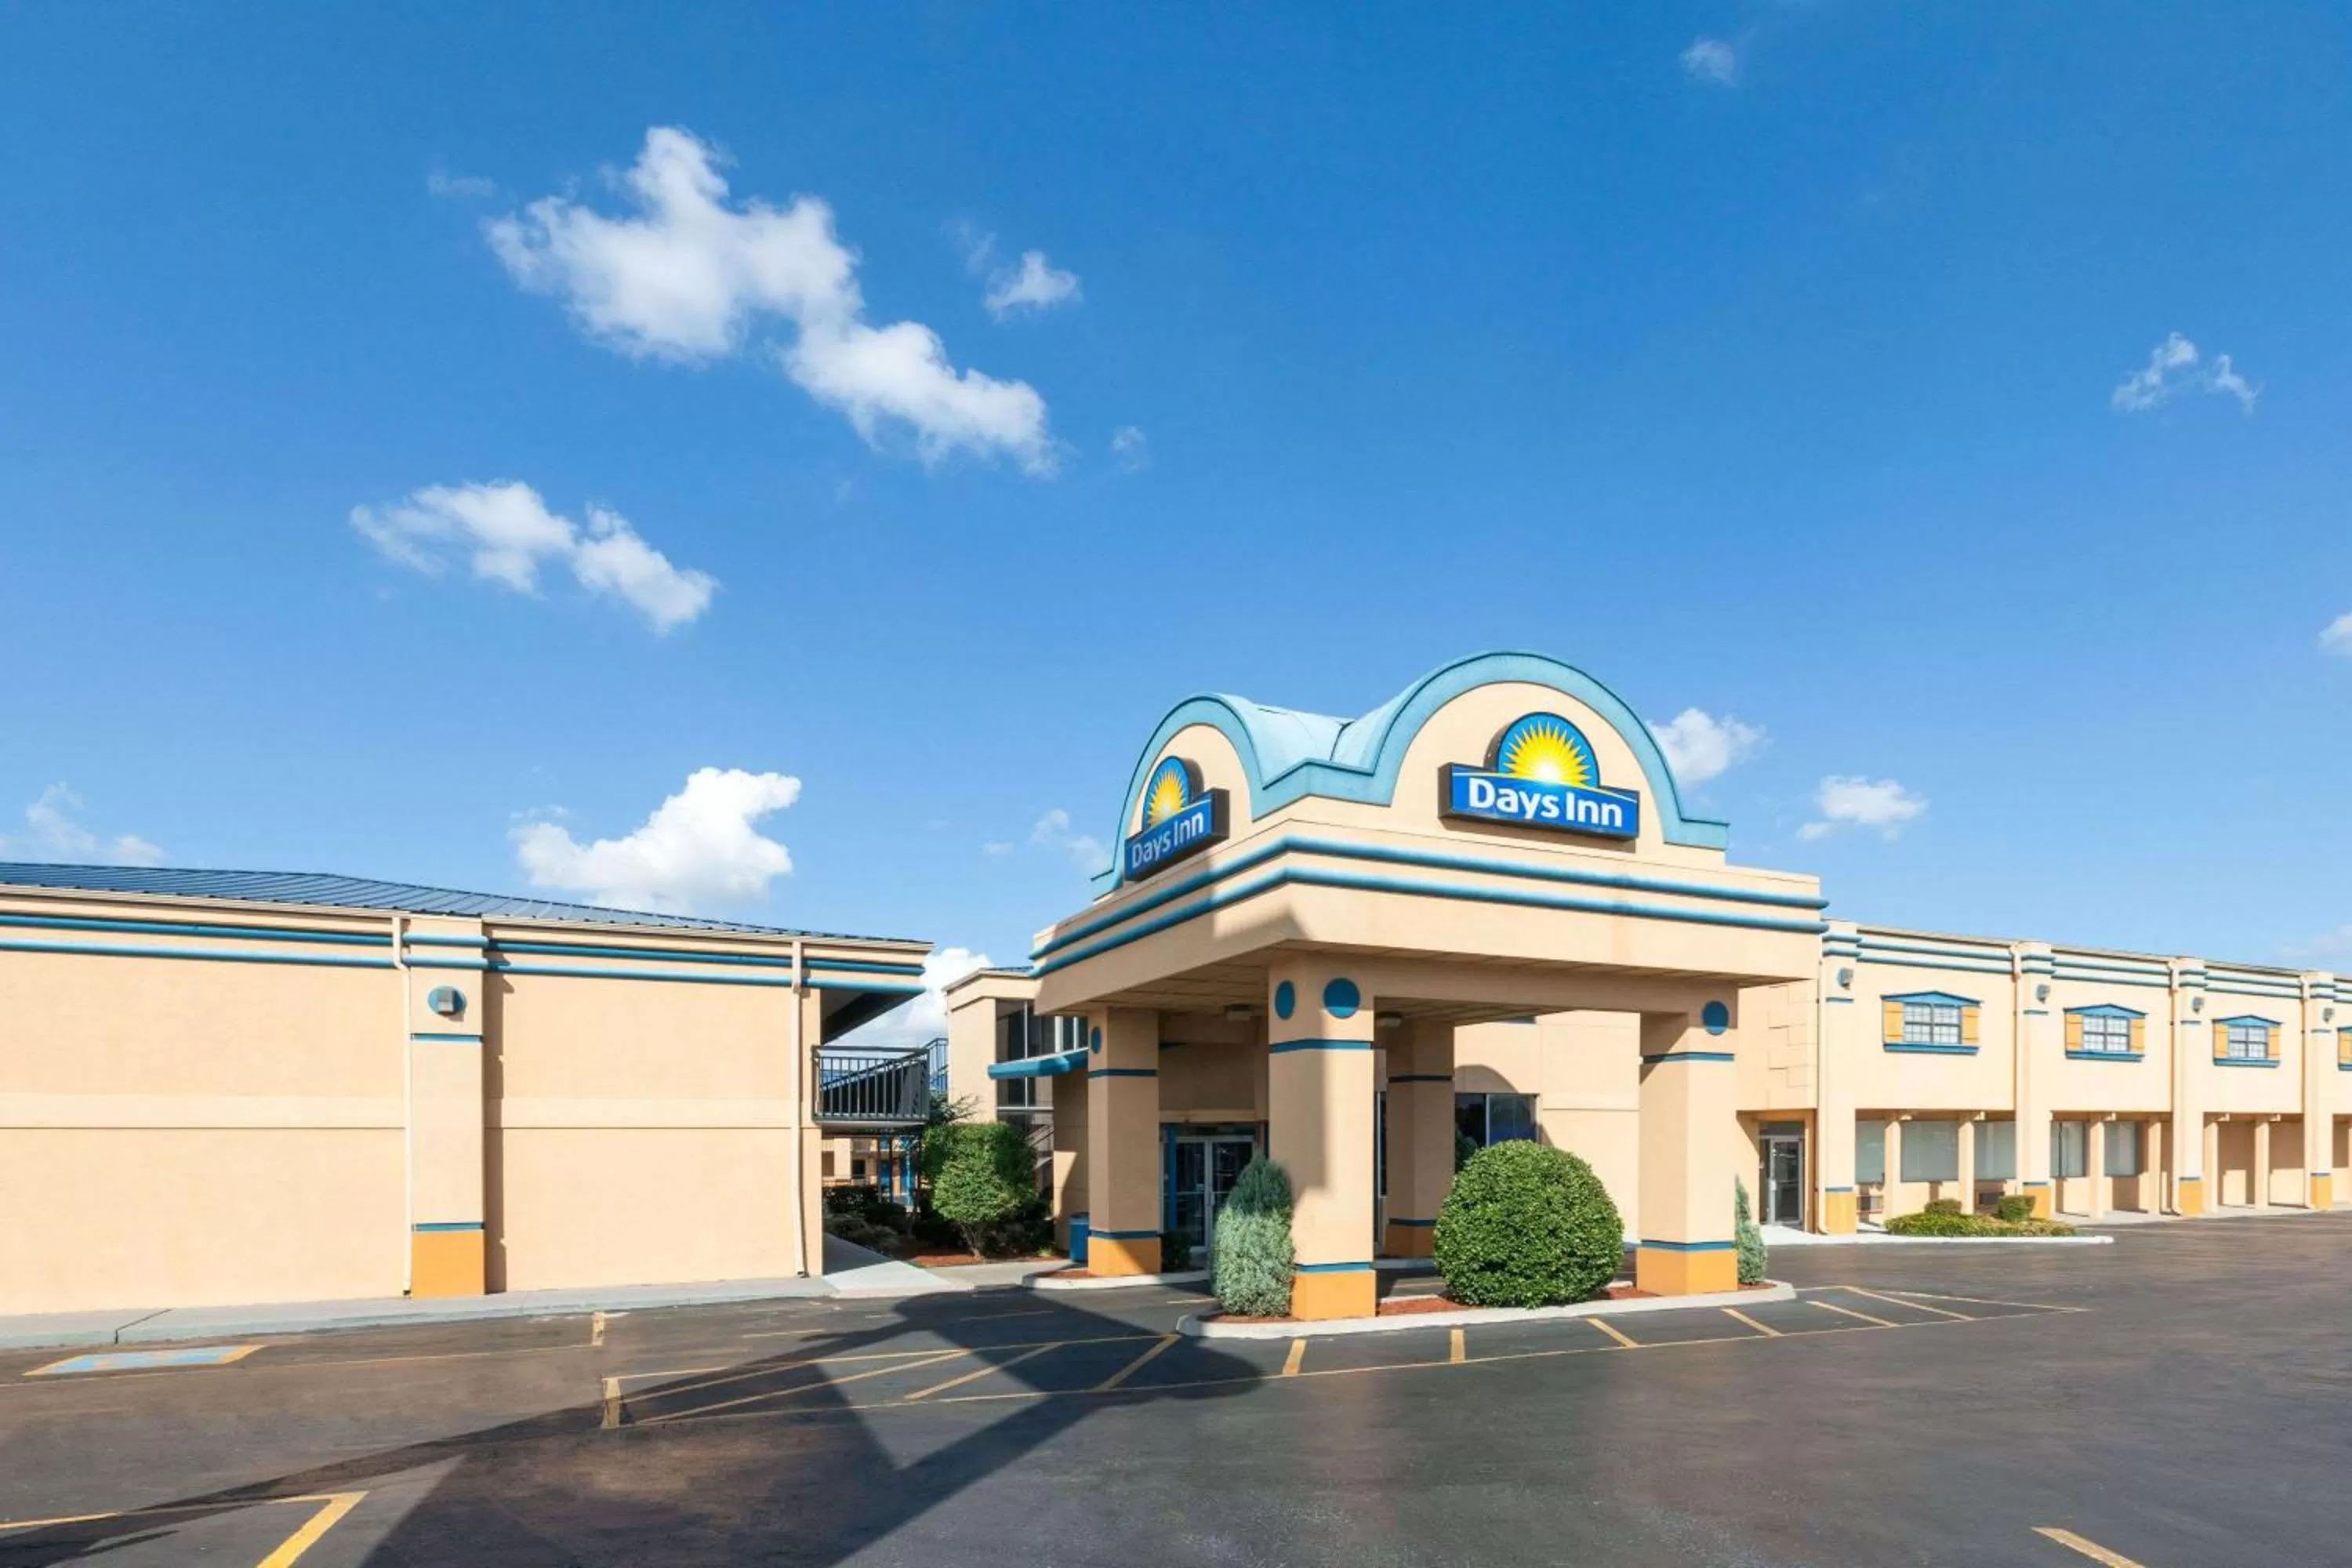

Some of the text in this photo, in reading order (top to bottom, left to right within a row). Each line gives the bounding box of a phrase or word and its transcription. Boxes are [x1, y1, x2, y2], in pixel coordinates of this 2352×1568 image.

[1468, 777, 1623, 828] Days Inn
[1131, 811, 1204, 869] Days Inn
